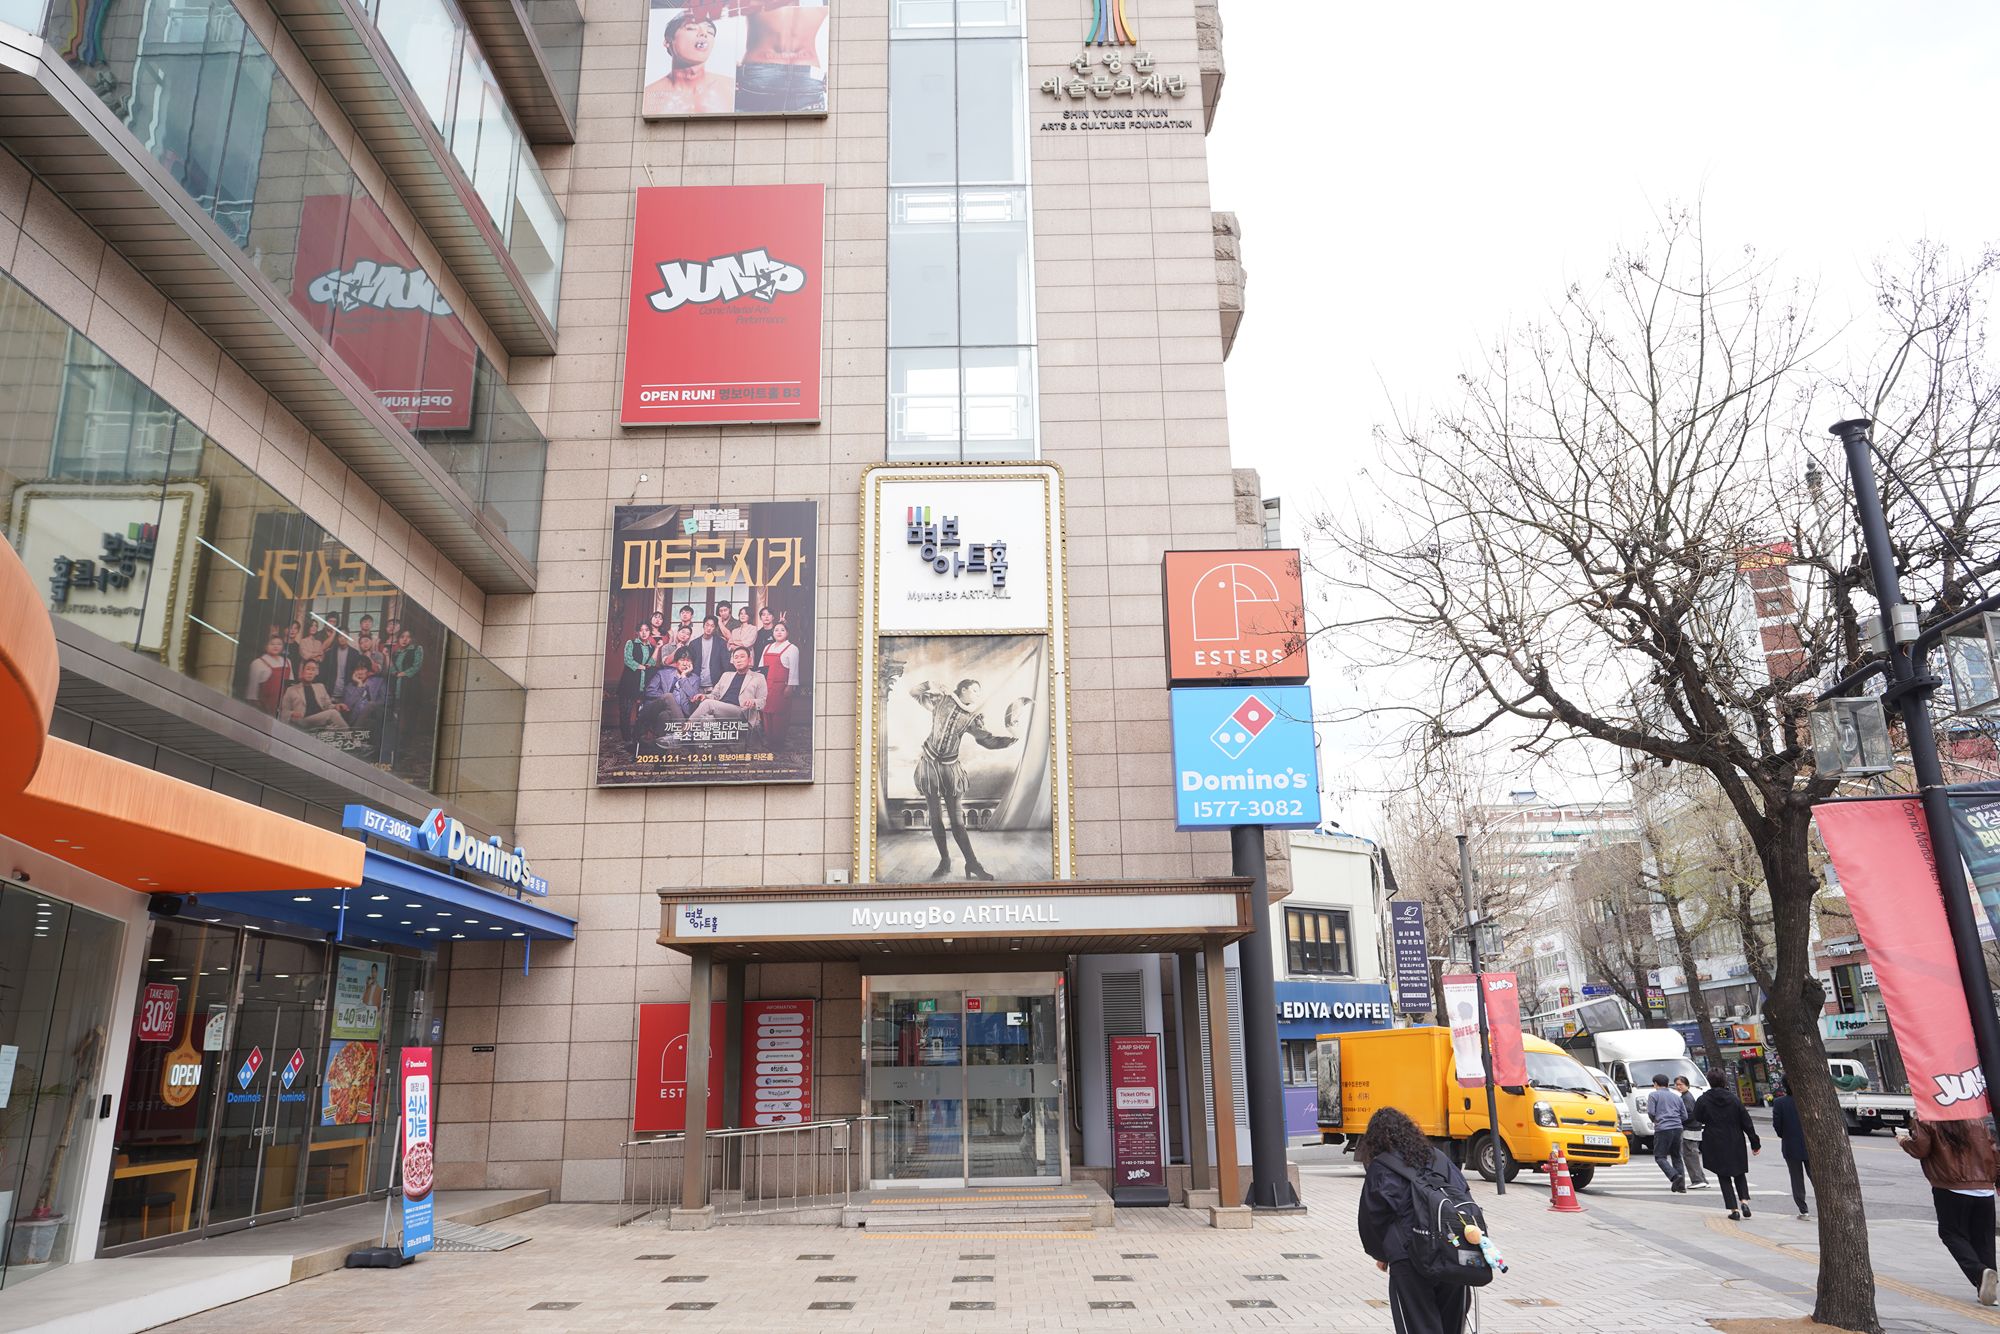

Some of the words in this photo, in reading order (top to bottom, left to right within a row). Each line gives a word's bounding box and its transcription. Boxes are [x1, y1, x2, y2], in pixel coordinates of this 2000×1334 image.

[1070, 51, 1155, 75] 신영균
[1040, 73, 1187, 100] 예술문화재단
[1062, 109, 1089, 119] SHIN
[1093, 109, 1133, 119] YOUNG
[1137, 108, 1169, 118] KYUN
[1040, 122, 1067, 131] ARTS
[1070, 122, 1078, 130] &
[1081, 121, 1126, 130] CULTURE
[1128, 120, 1193, 129] FOUNDATION
[645, 247, 807, 312] JUMP
[699, 305, 726, 315] Comic
[754, 304, 770, 314] Arts
[640, 390, 679, 402] OPEN
[681, 389, 716, 401] RUN!
[783, 387, 801, 399] B3
[620, 537, 806, 590] 마트로시카
[907, 590, 958, 603] MyungBo
[960, 589, 1011, 600] ARTHALL
[1194, 648, 1284, 666] ESTERS
[637, 754, 679, 763] 2025.12.1
[687, 753, 712, 762] 12.31
[1182, 767, 1308, 792] Domino's
[1194, 800, 1304, 819] 1577-3082
[1902, 802, 1922, 831] Comic
[364, 810, 413, 842] 1577-3082
[447, 819, 532, 887] Domino's
[851, 906, 956, 930] MyungBo
[962, 904, 1061, 924] ARTHALL
[149, 988, 174, 999] TAKE-OUT
[142, 1000, 174, 1032] 30%
[1283, 1002, 1331, 1019] EDIYA
[1333, 1002, 1391, 1019] COFFEE
[160, 1021, 173, 1032] OFF
[171, 1064, 202, 1086] OPEN
[408, 1094, 428, 1116] 식사
[408, 1116, 427, 1138] 가능
